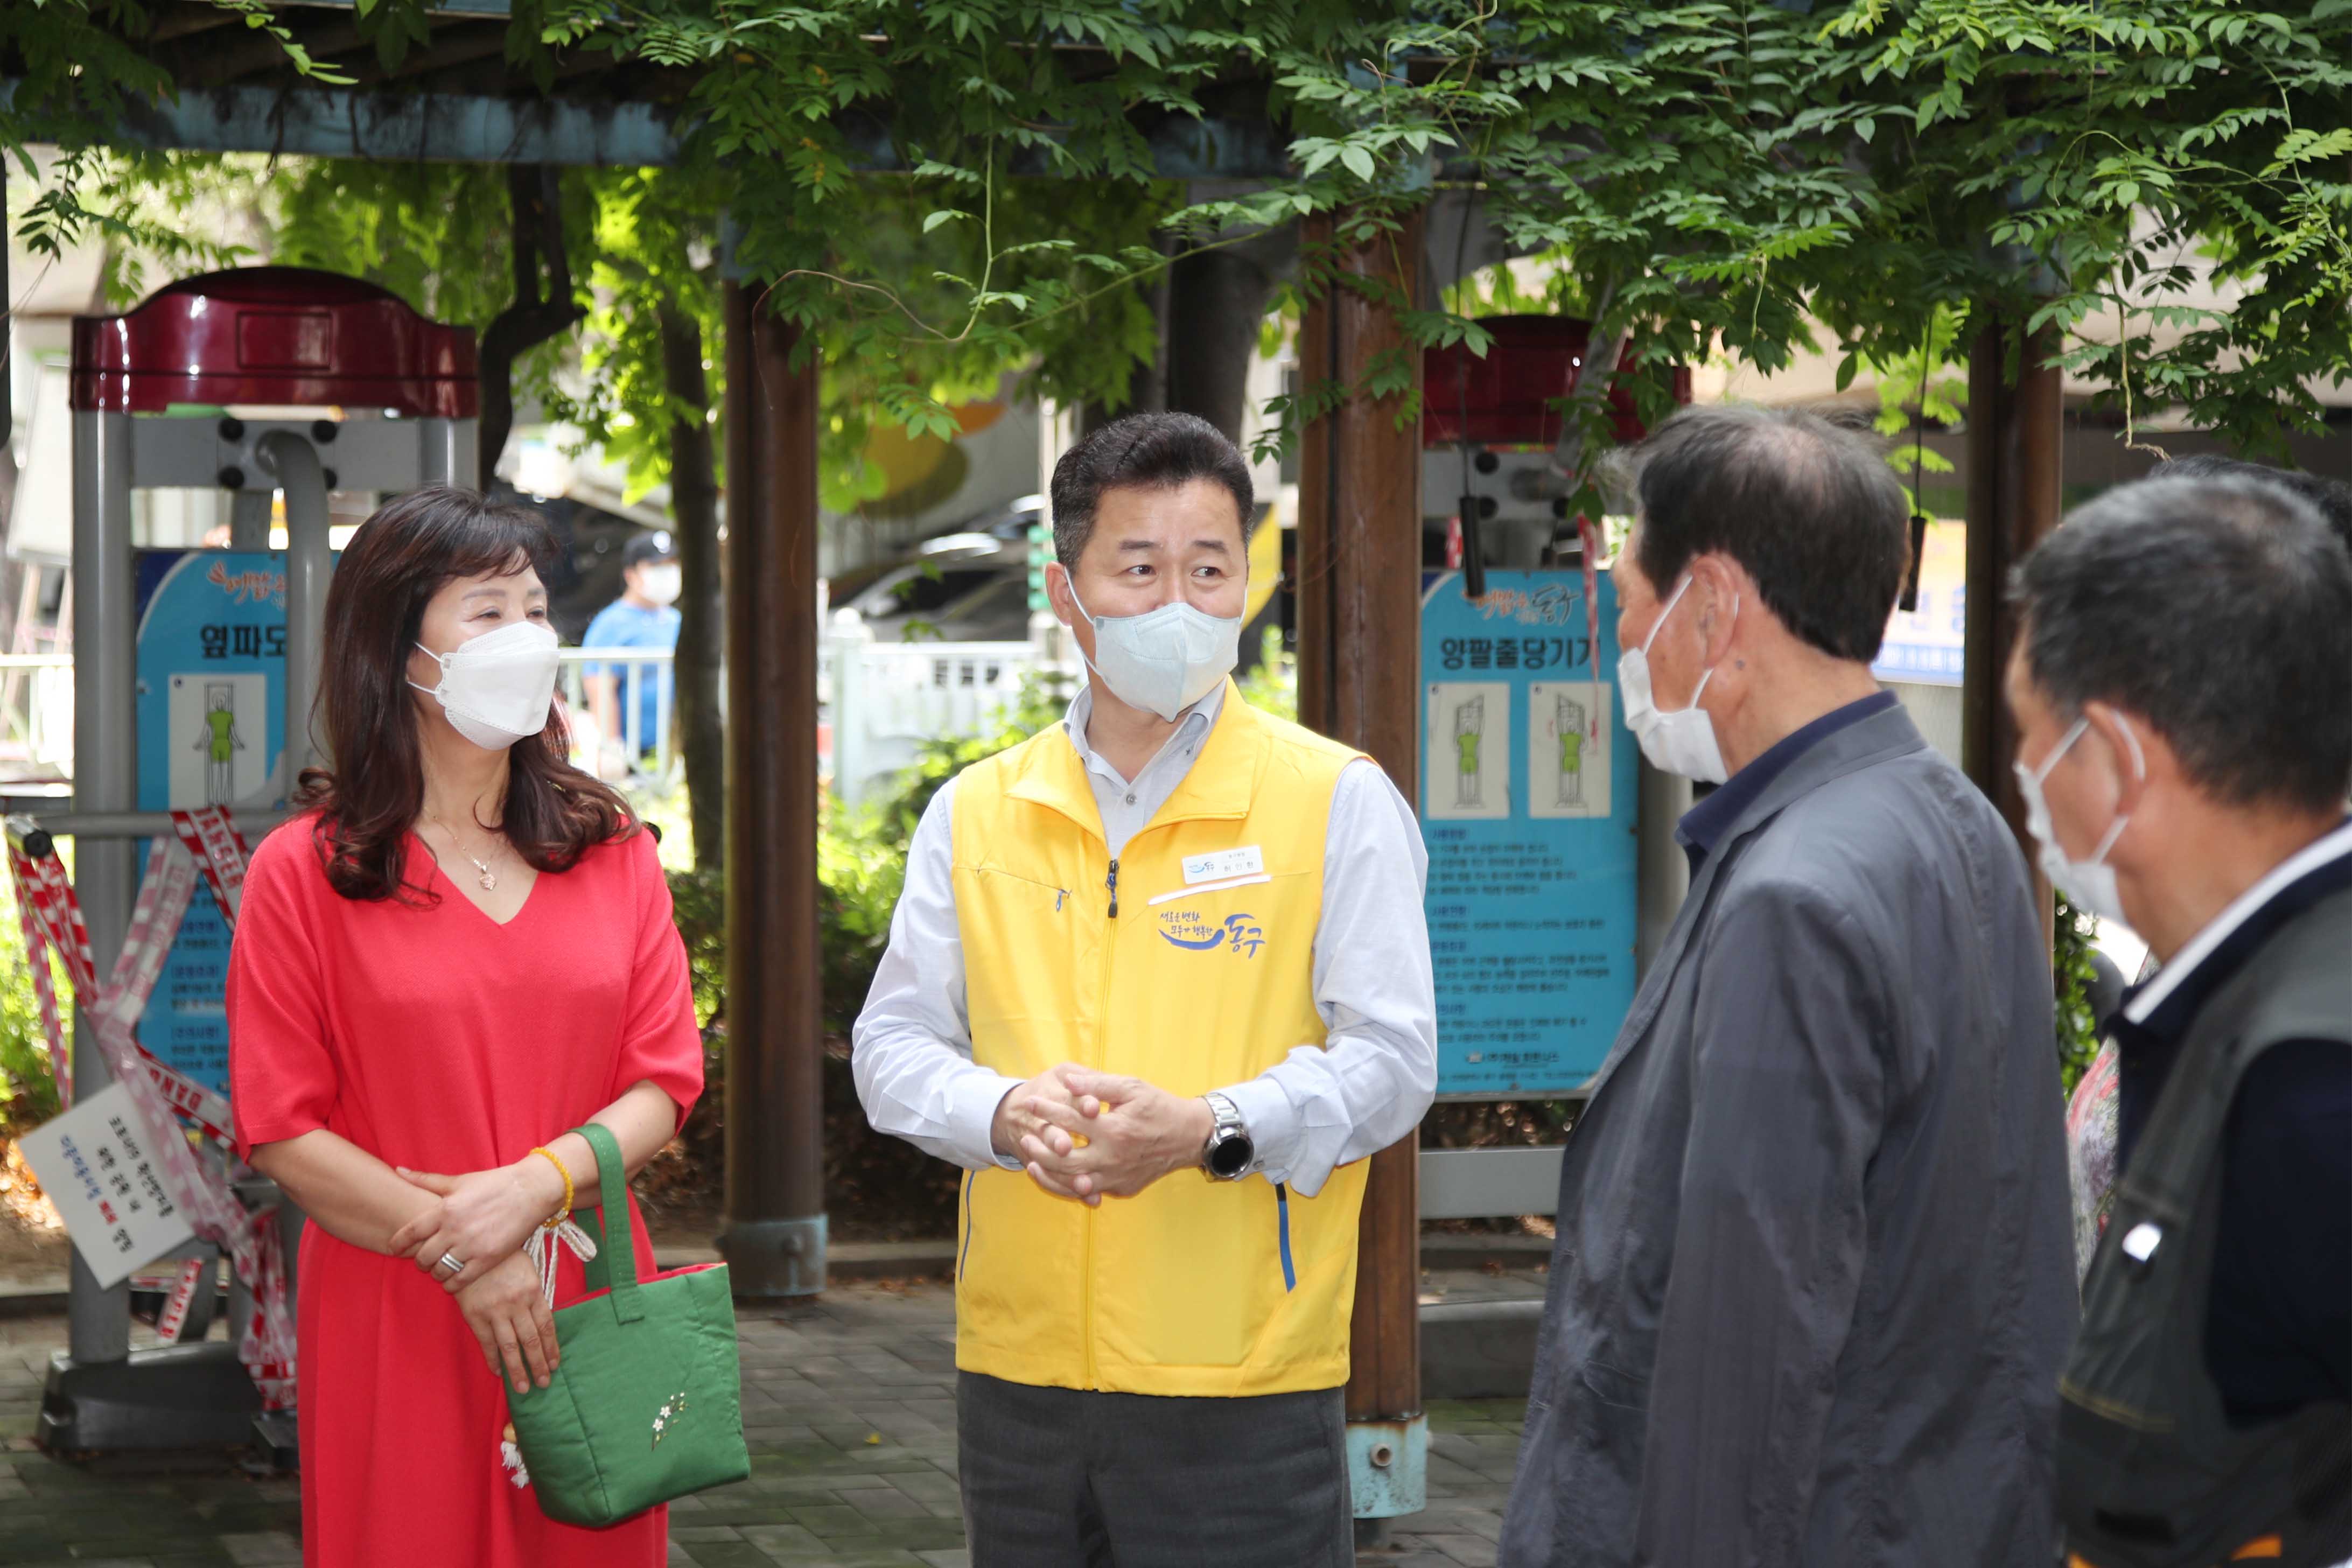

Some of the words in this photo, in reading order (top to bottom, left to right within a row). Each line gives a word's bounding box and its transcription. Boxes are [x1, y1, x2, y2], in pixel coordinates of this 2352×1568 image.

[1160, 911, 1180, 923] 새로운
[1181, 911, 1200, 923] 변화
[1171, 925, 1191, 938] 모두가
[1193, 924, 1214, 939] 행복한
[1224, 913, 1266, 959] 동구
